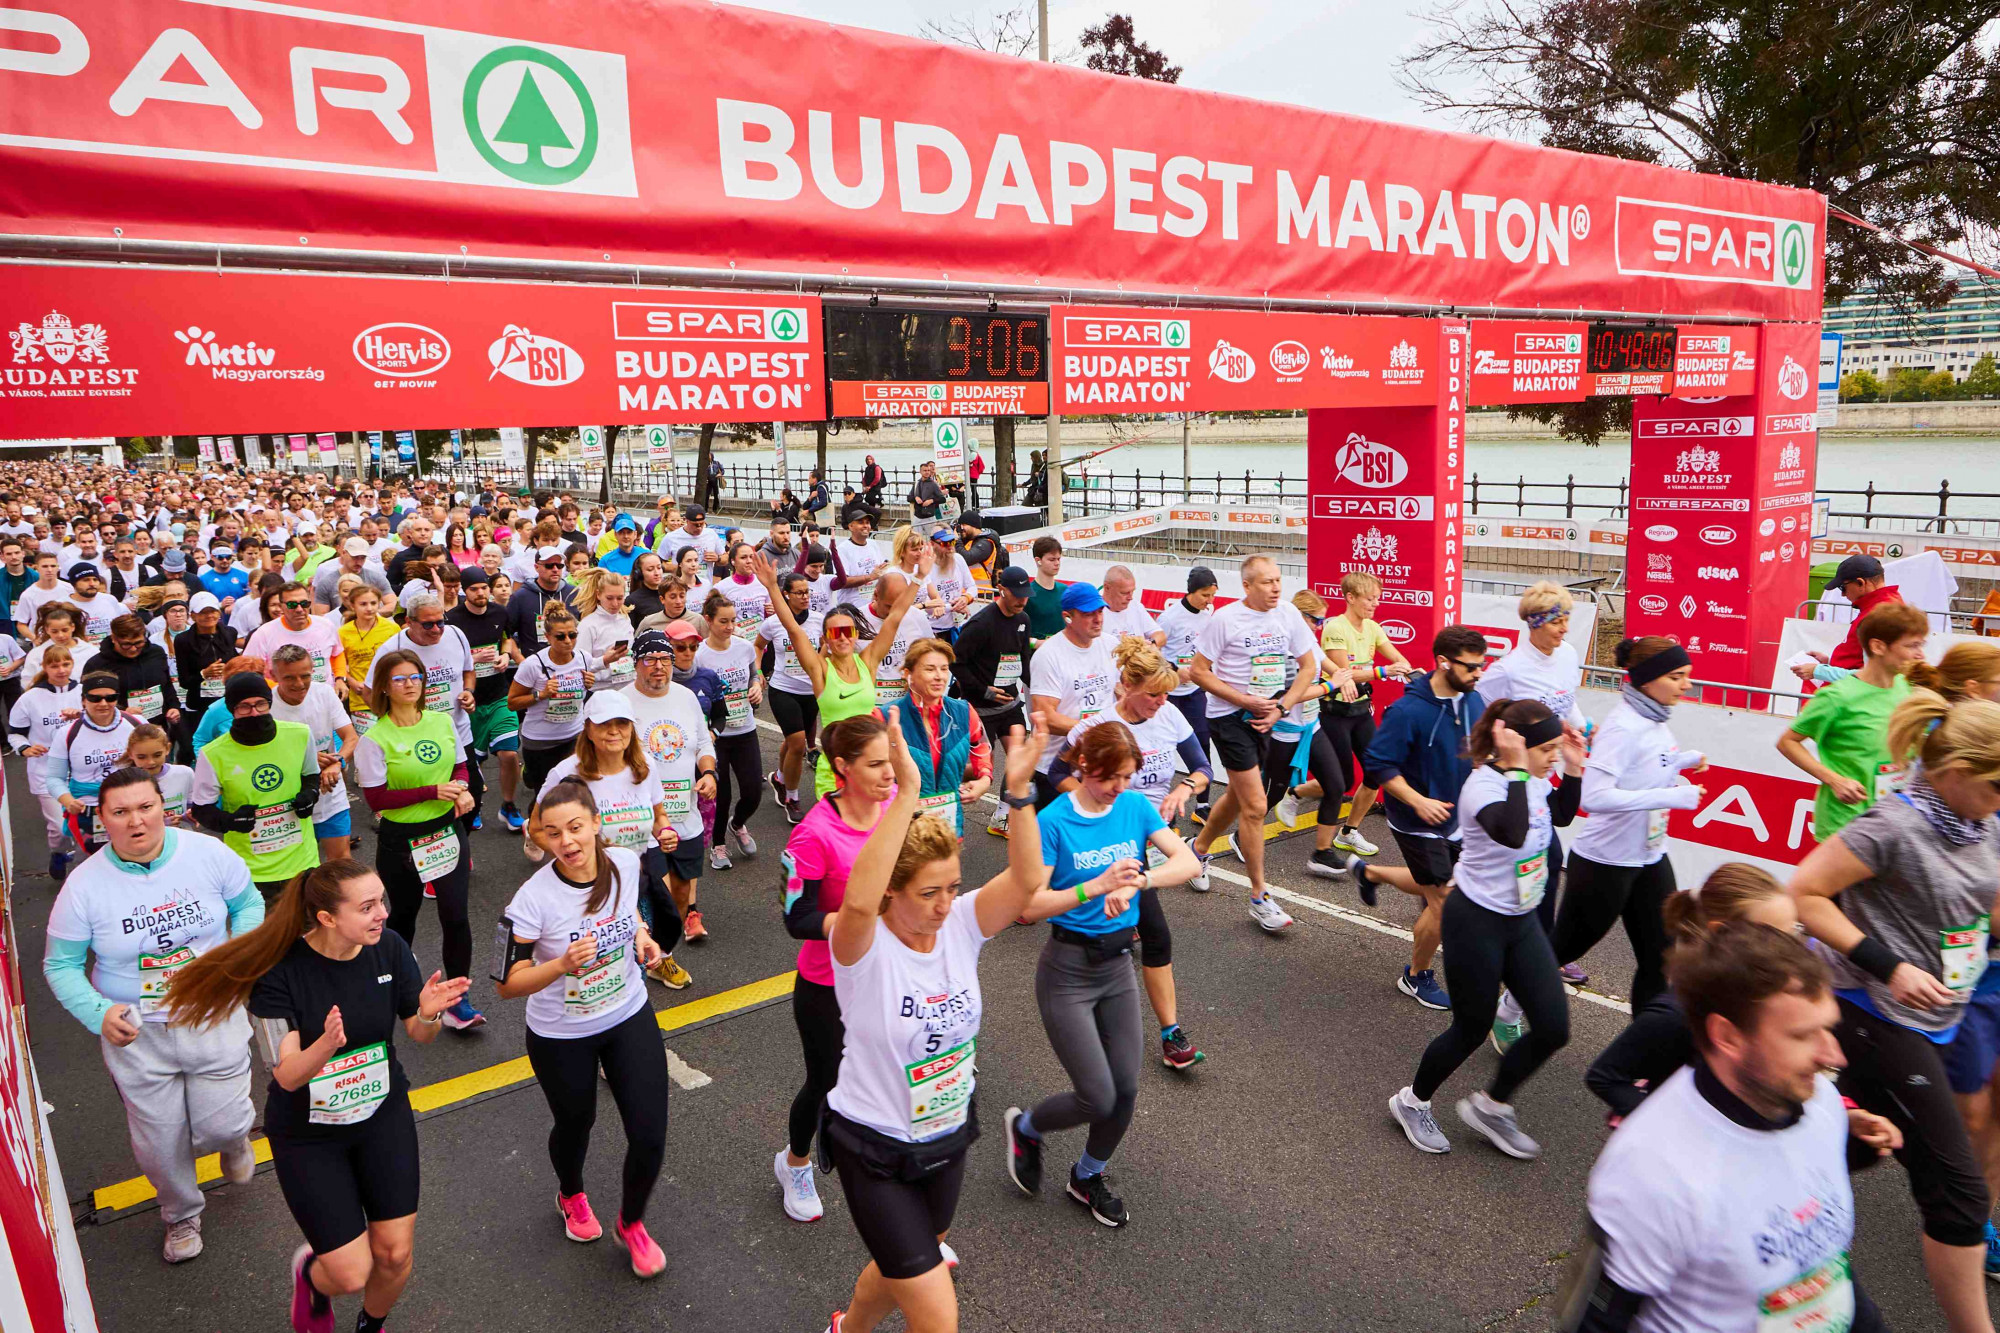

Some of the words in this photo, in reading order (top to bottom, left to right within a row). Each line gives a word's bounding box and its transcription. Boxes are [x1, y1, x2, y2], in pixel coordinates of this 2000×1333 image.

[717, 97, 1253, 240] BUDAPEST
[1652, 219, 1772, 271] SPAR
[646, 312, 762, 334] SPAR
[1085, 324, 1160, 342] SPAR
[364, 335, 442, 365] Hervis
[1525, 337, 1565, 350] SPAR
[1593, 330, 1674, 370] 10:48:06
[1686, 339, 1718, 350] SPAR
[377, 360, 408, 368] SPORTS
[527, 347, 567, 381] BSI
[615, 350, 810, 378] BUDAPEST
[1274, 349, 1306, 368] Hervis
[1677, 358, 1729, 372] BUDAPEST
[212, 366, 325, 381] Magyarország
[1064, 355, 1191, 378] BUDAPEST
[1227, 355, 1247, 379] BSI
[1331, 368, 1370, 379] Magyarország
[1382, 369, 1425, 379] BUDAPEST
[1513, 358, 1582, 375] BUDAPEST
[374, 380, 395, 388] GET
[1601, 376, 1623, 384] SPAR
[1632, 375, 1665, 384] BUDAPEST
[1790, 371, 1804, 396] BSI
[50, 388, 85, 398] AMELY
[89, 387, 132, 397] EGYESÍT
[877, 387, 927, 397] SPAR
[953, 386, 1027, 399] BUDAPEST
[1630, 383, 1662, 395] FESZTIVÁL
[951, 398, 1025, 415] FESZTIVÁL
[1447, 338, 1460, 490] BUDAPEST
[1654, 421, 1718, 434] SPAR
[1773, 418, 1802, 431] SPAR
[1363, 452, 1394, 483] BSI
[1663, 474, 1733, 484] BUDAPEST
[1773, 469, 1806, 482] BUDAPEST
[1328, 500, 1395, 515] SPAR
[1645, 500, 1733, 509] INTERSPAR
[1764, 494, 1806, 508] INTERSPAR
[1121, 515, 1154, 530] SPAR
[1177, 511, 1210, 520] SPAR
[1236, 514, 1271, 523] SPAR
[1069, 527, 1100, 540] SPAR
[1512, 527, 1563, 538] SPAR
[1648, 529, 1676, 537] Regnum
[1813, 541, 1884, 557] SPAR
[1340, 562, 1412, 577] BUDAPEST
[1697, 565, 1740, 581] RISKA
[1324, 586, 1415, 602] INPAR
[742, 611, 748, 619] 5
[1141, 772, 1157, 786] 10
[663, 801, 687, 810] 8709
[263, 816, 285, 827] RISKA
[260, 821, 297, 838] 28438
[424, 845, 458, 866] 28430
[426, 842, 445, 854] RISKA
[122, 900, 201, 935] BUDAPEST
[157, 933, 174, 950] 5
[583, 970, 609, 986] RISKA
[579, 974, 622, 1000] 28638
[925, 1034, 943, 1053] 5
[323, 1053, 367, 1074] SPAR
[335, 1072, 366, 1090] RISKA
[328, 1080, 382, 1108] 27688
